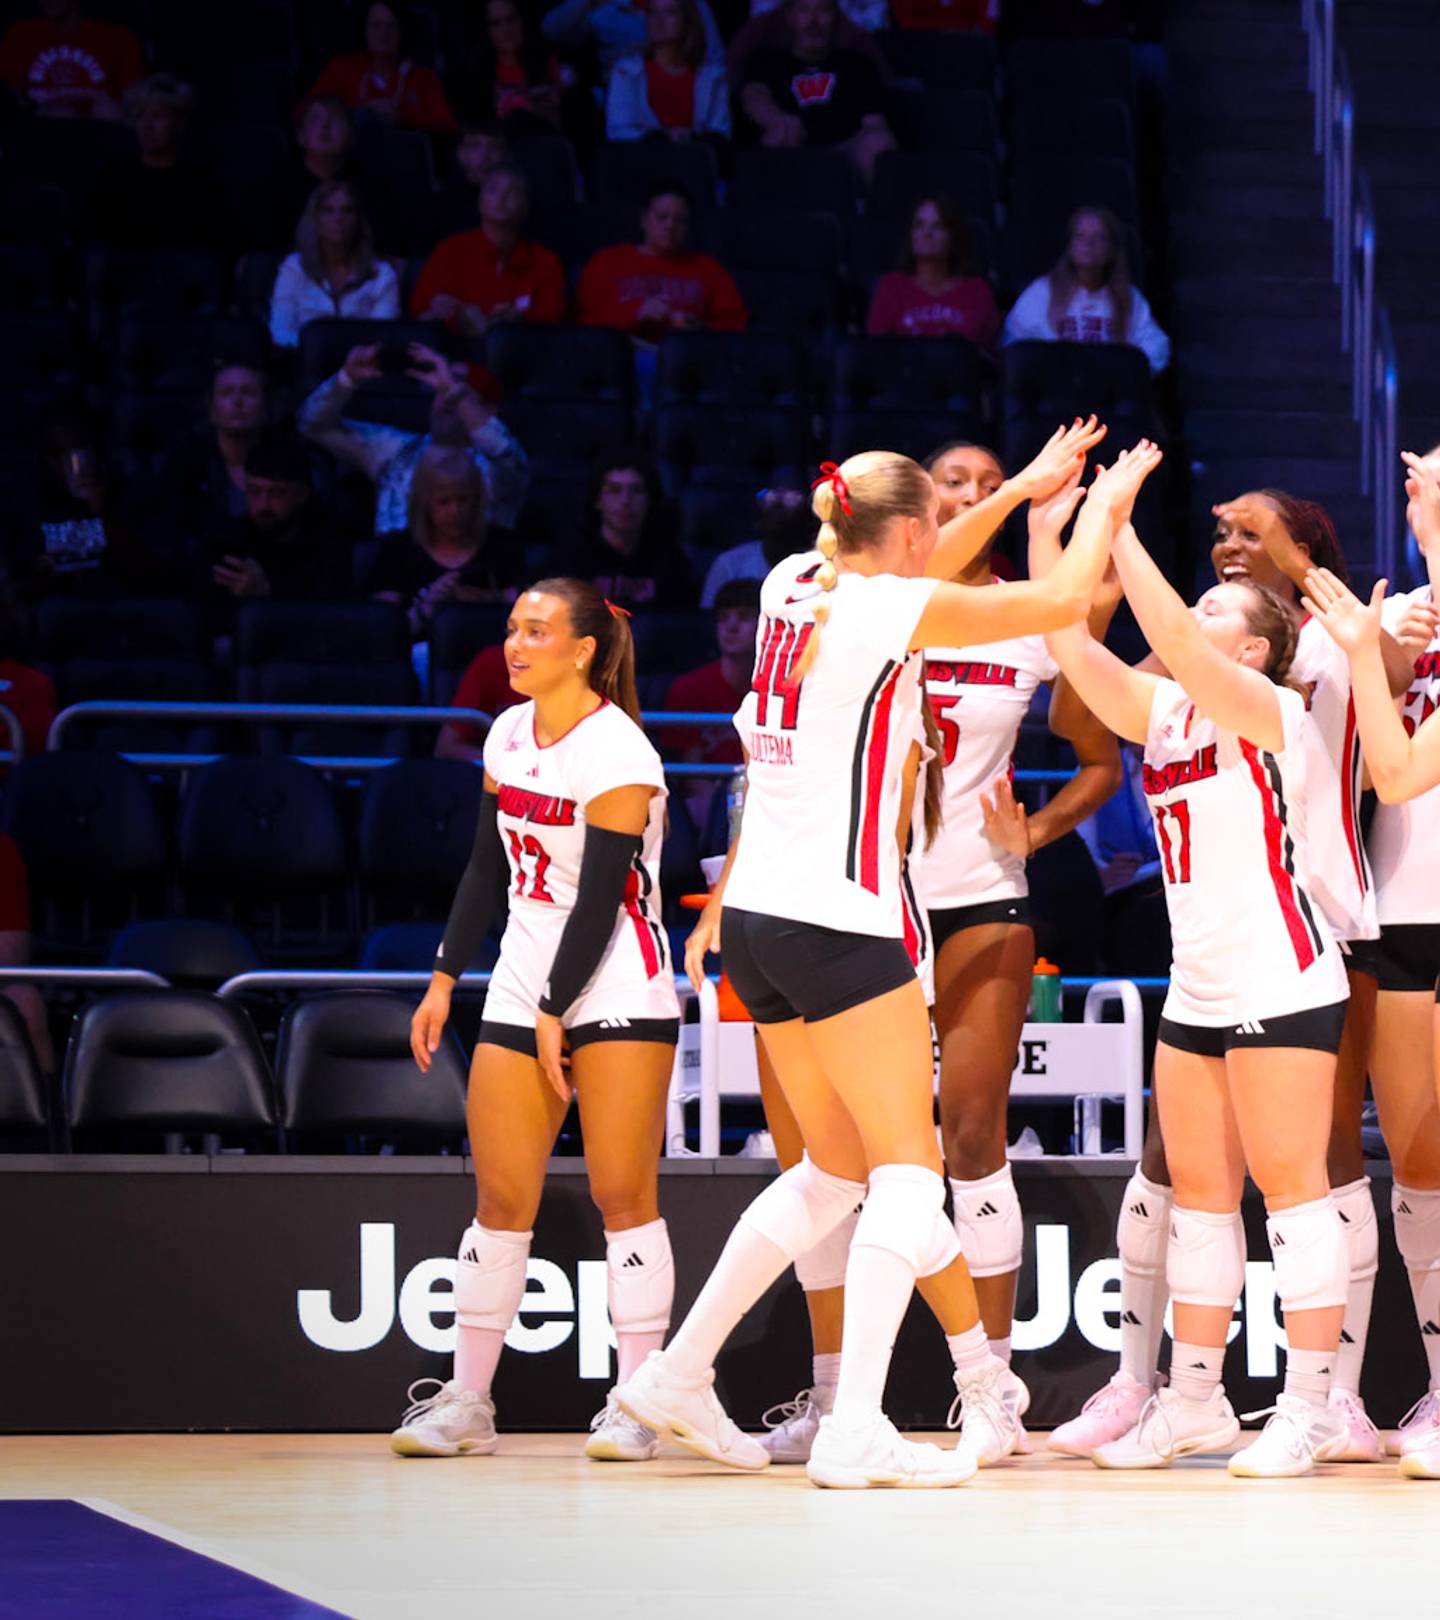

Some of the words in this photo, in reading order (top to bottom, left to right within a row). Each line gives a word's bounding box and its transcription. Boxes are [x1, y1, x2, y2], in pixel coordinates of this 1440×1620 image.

[751, 614, 817, 731] 44
[504, 827, 556, 904] 12
[1153, 799, 1191, 885] 17
